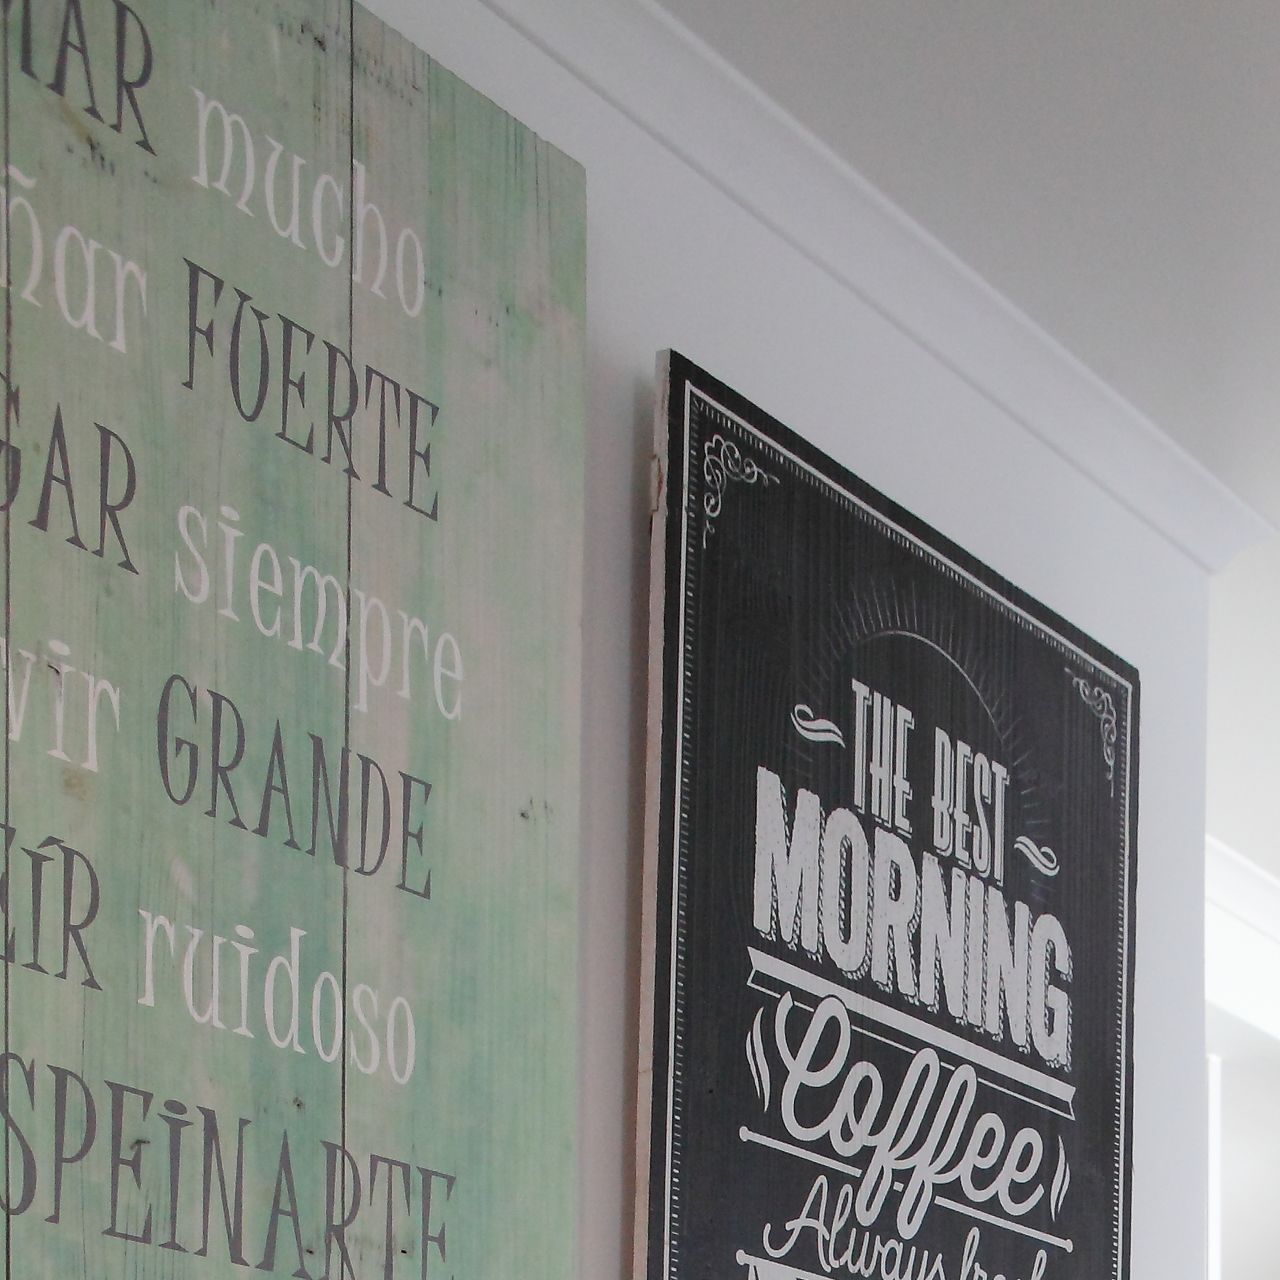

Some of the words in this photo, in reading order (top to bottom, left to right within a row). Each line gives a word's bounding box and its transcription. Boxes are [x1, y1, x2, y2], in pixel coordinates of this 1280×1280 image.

[191, 87, 426, 318] mucho
[181, 257, 440, 522] FUERTE
[174, 505, 465, 721] siempre
[157, 673, 433, 900] GRANDE
[852, 678, 915, 837] THE
[932, 727, 1010, 886] BEST
[137, 909, 416, 1085] ruidoso
[753, 766, 1073, 1072] MORNING
[774, 990, 1046, 1239] Coffee
